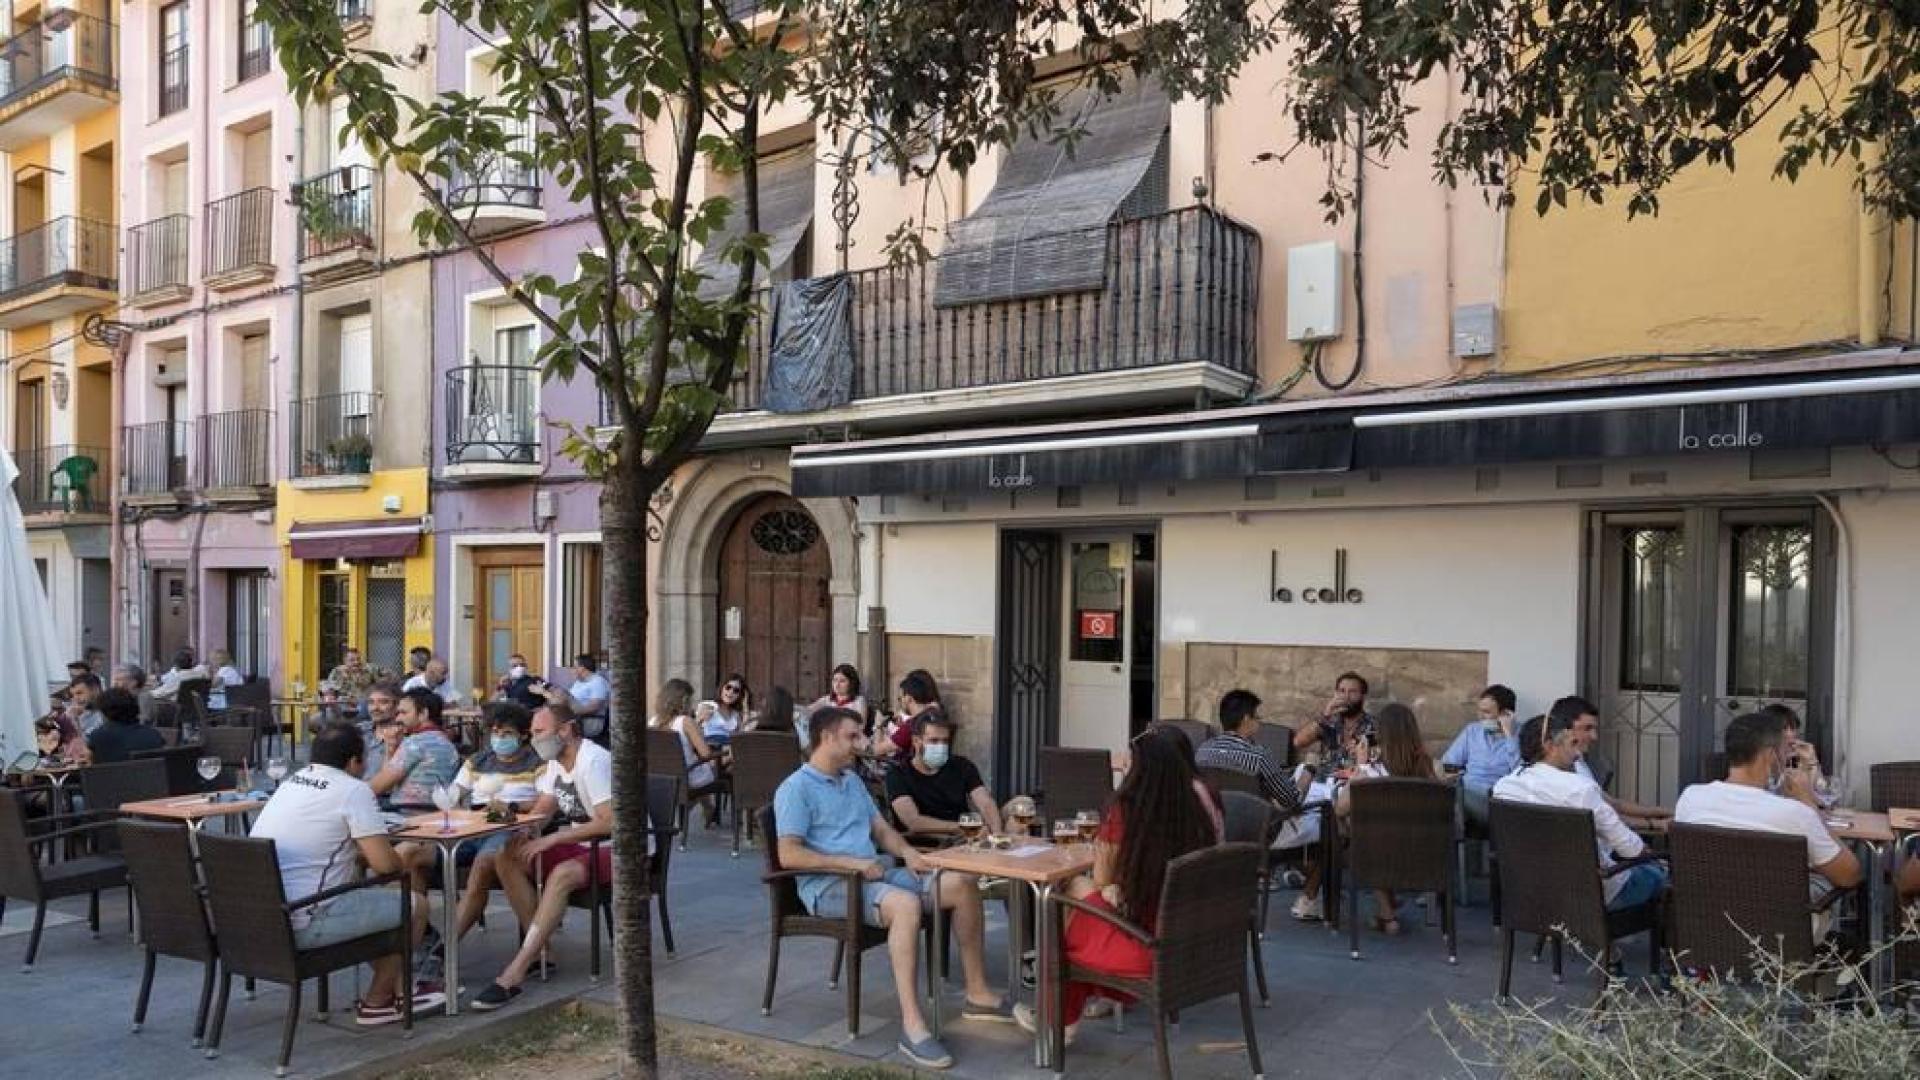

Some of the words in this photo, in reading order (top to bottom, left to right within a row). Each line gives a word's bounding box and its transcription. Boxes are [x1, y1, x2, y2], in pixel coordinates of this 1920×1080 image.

[1679, 406, 1699, 449] la
[1708, 402, 1763, 447] calle
[988, 457, 1001, 488] la
[1004, 455, 1033, 486] calle
[1270, 549, 1293, 603] la
[1302, 548, 1363, 603] calle
